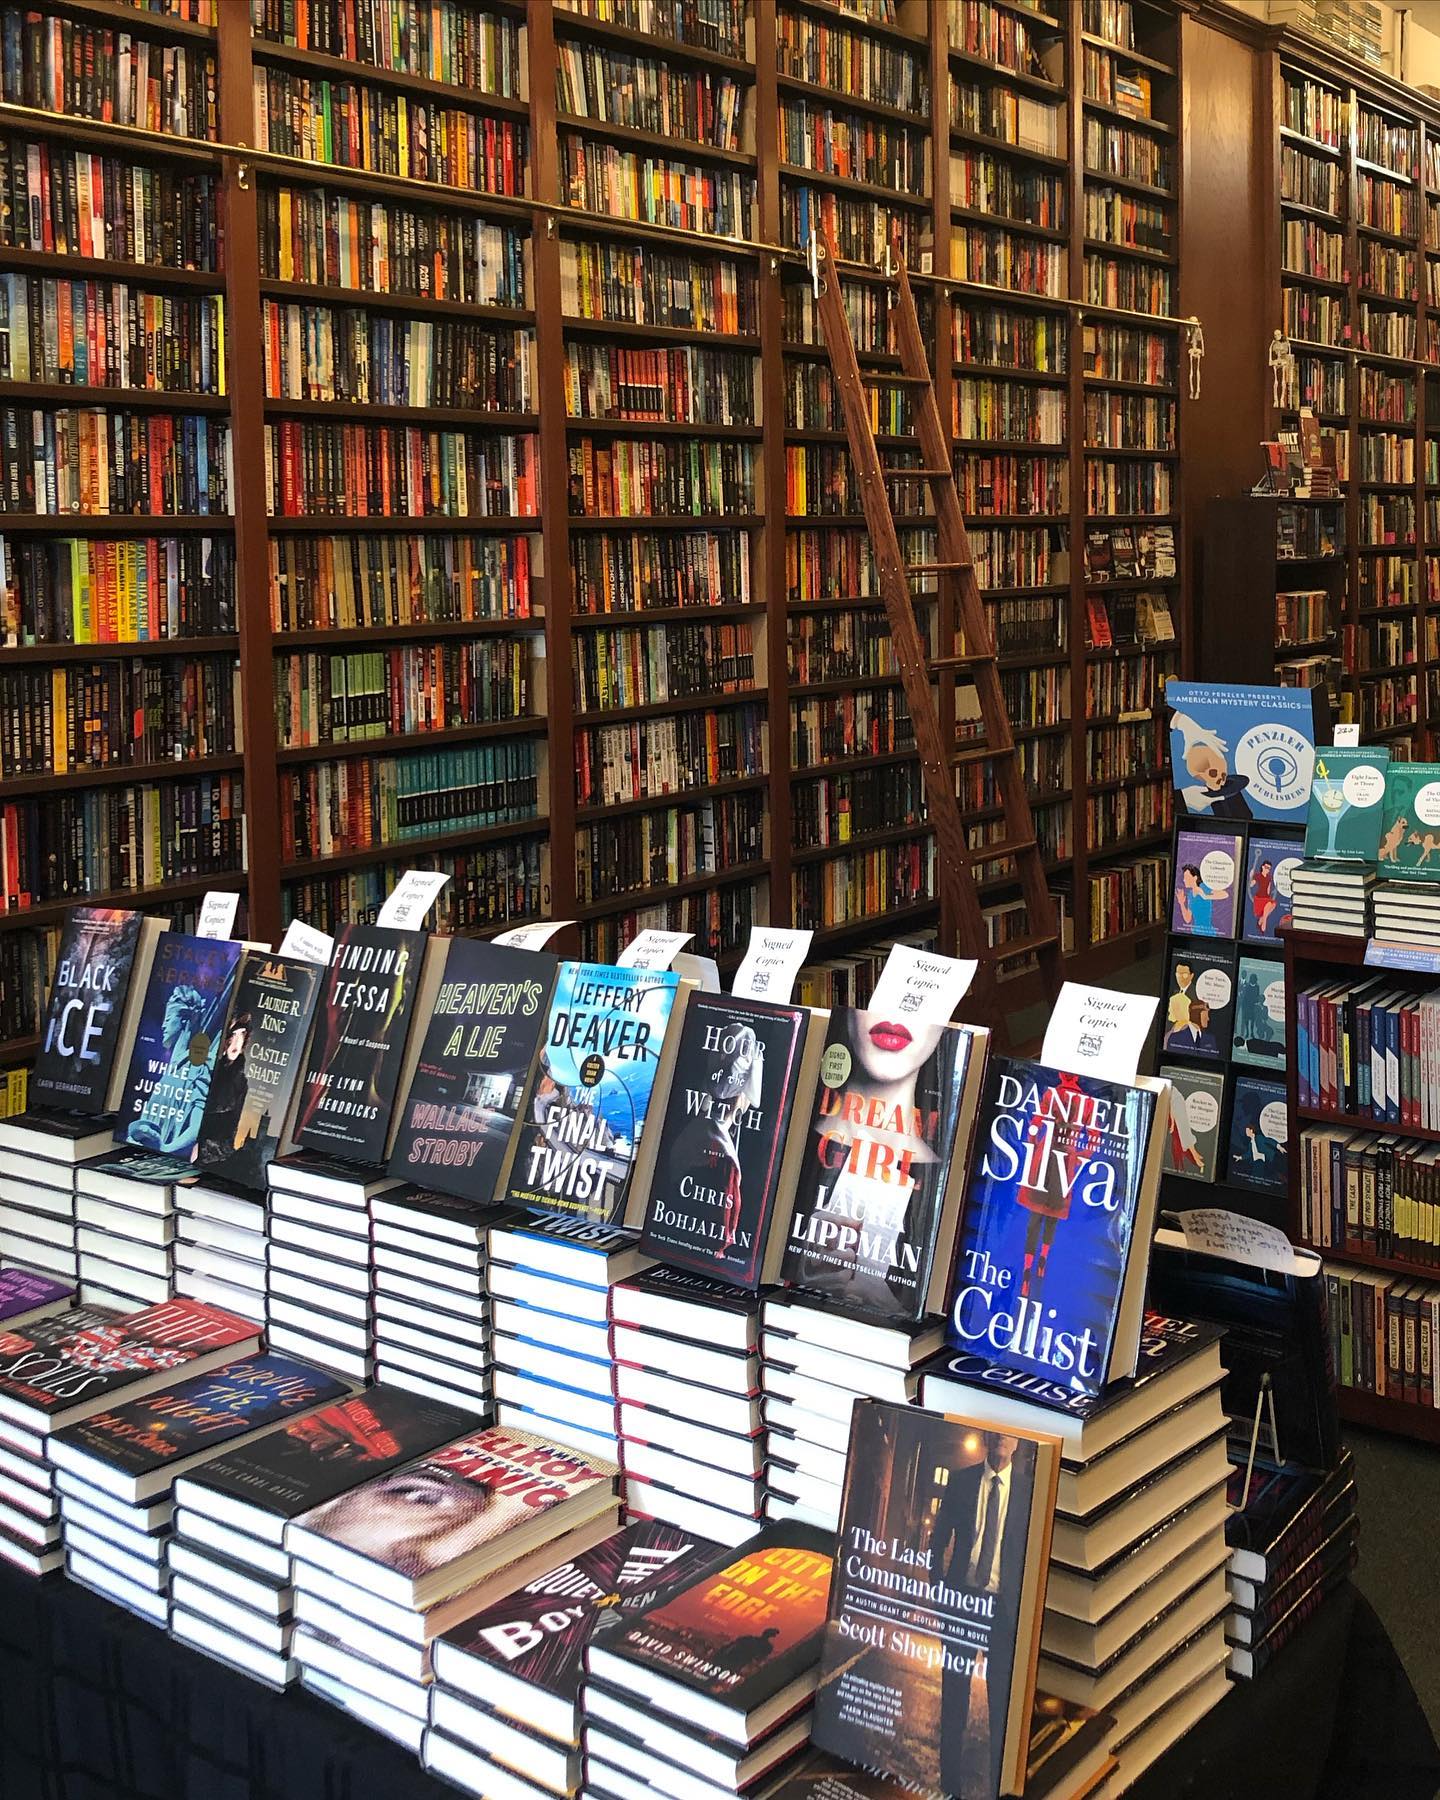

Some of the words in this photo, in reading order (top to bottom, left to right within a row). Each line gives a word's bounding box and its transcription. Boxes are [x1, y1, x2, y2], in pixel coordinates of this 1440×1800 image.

[81, 195, 89, 212] MAN
[75, 289, 83, 316] JOHN
[164, 298, 172, 337] BRIGHTON
[76, 319, 84, 345] HART
[8, 411, 16, 422] AM
[9, 423, 17, 449] PILGRIM
[10, 461, 18, 481] TERRY
[90, 469, 98, 484] KILL
[11, 481, 19, 500] HAYES
[586, 486, 594, 506] MEYER
[97, 554, 106, 577] CARL
[107, 542, 117, 573] CARL
[138, 545, 146, 572] CARL
[97, 586, 106, 626] HIAASEN
[107, 580, 118, 633] HIAASEN
[139, 581, 148, 629] HIAASEN
[599, 668, 608, 700] MOSLEY
[1212, 691, 1244, 699] PENZLER
[1247, 693, 1287, 701] PRESENTS
[1175, 696, 1213, 705] AMERICAN
[1216, 697, 1259, 708] MYSTERY
[1261, 700, 1301, 710] CLASSICS
[1246, 730, 1305, 753] PENZLER
[1253, 783, 1306, 802] PUBLISHERS
[402, 891, 424, 900] Copies
[410, 877, 436, 887] Signed
[206, 901, 229, 910] Signed
[204, 915, 225, 924] Copies
[637, 946, 664, 954] Copies
[647, 935, 677, 943] Signed
[761, 938, 794, 951] Signed
[332, 943, 409, 976] FINDING
[755, 956, 785, 966] Copies
[913, 959, 951, 975] Signed
[58, 961, 115, 991] BLACK
[595, 971, 609, 979] TIMES
[610, 972, 643, 982] BESTSELLING
[644, 976, 665, 984] AUTHOR
[904, 975, 940, 990] Copies
[257, 993, 291, 1014] LAURIE
[332, 981, 390, 1014] TESSA
[434, 980, 543, 1016] HEAVEN'S
[574, 981, 646, 1014] JEFFERY
[1084, 997, 1127, 1013] Signed
[261, 1014, 287, 1034] KING
[1079, 1014, 1119, 1030] Copies
[345, 1037, 358, 1046] Novel
[366, 1040, 390, 1050] Suspense
[443, 1025, 464, 1057] A
[465, 1025, 506, 1058] LIE
[550, 1013, 651, 1063] DEAVER
[702, 1024, 766, 1062] HOUR
[250, 1043, 290, 1067] CASTLE
[828, 1062, 843, 1070] FIRST
[829, 1051, 847, 1060] SIGNED
[149, 1059, 189, 1080] WHILE
[247, 1063, 281, 1085] SHADE
[307, 1071, 334, 1087] JAIME
[337, 1075, 364, 1091] LYNN
[711, 1069, 723, 1083] of
[727, 1074, 746, 1088] the
[825, 1072, 843, 1082] EDITION
[134, 1079, 192, 1101] JUSTICE
[574, 1085, 596, 1106] THE
[133, 1099, 184, 1123] SLEEPS
[318, 1097, 378, 1120] HENDRICKS
[410, 1103, 495, 1133] WALLACE
[685, 1088, 765, 1132] WITCH
[820, 1087, 940, 1141] DREAM
[995, 1074, 1133, 1141] DANIEL
[545, 1105, 608, 1151] FINAL
[1070, 1129, 1085, 1141] NEW
[1087, 1133, 1105, 1145] YORK
[408, 1138, 483, 1167] STROBY
[1057, 1136, 1101, 1153] BESTSELLING
[527, 1146, 613, 1201] TWIST
[816, 1130, 921, 1191] GIRL
[980, 1113, 1121, 1212] Silva
[680, 1175, 734, 1210] CHRIS
[814, 1184, 906, 1234] LAURA
[530, 1211, 629, 1249] TWIST
[653, 1200, 752, 1249] BOHJALIAN
[791, 1212, 922, 1273] LIPPMAN
[789, 1245, 802, 1255] NEW
[803, 1249, 821, 1260] YORK
[822, 1253, 842, 1266] TIMES
[843, 1259, 887, 1279] BESTSELLING
[888, 1271, 917, 1288] AUTHOR
[965, 1249, 1011, 1289] The
[953, 1285, 1098, 1379] Cellist
[0, 1352, 108, 1397] SOULS
[209, 1365, 318, 1406] SURVIVE
[194, 1385, 268, 1410] THE
[135, 1396, 249, 1433] NIGHT
[471, 1429, 606, 1485] ELLROY
[535, 1443, 586, 1468] JAMES
[428, 1465, 452, 1478] NOVEL
[429, 1450, 569, 1507] PANIC
[462, 1447, 567, 1492] WIDESPREAD
[851, 1526, 887, 1557] The
[891, 1538, 934, 1571] Last
[615, 1543, 695, 1585] THE
[762, 1548, 834, 1584] CITY
[523, 1563, 605, 1605] QUIET
[717, 1559, 765, 1585] ON
[768, 1575, 825, 1609] THE
[846, 1554, 995, 1619] Commandment
[621, 1591, 656, 1609] BEN
[702, 1584, 782, 1624] EDGE
[845, 1594, 854, 1602] AN
[855, 1596, 878, 1609] AUSTIN
[879, 1603, 900, 1616] GRANT
[902, 1609, 911, 1619] OF
[913, 1612, 946, 1631] SCOTLAND
[948, 1622, 965, 1636] YARD
[967, 1628, 988, 1642] NOVEL
[477, 1605, 587, 1660] BOY
[626, 1630, 674, 1657] DAVID
[672, 1647, 742, 1685] SWINSON
[837, 1613, 887, 1650] Scott
[889, 1631, 988, 1681] Shepherd
